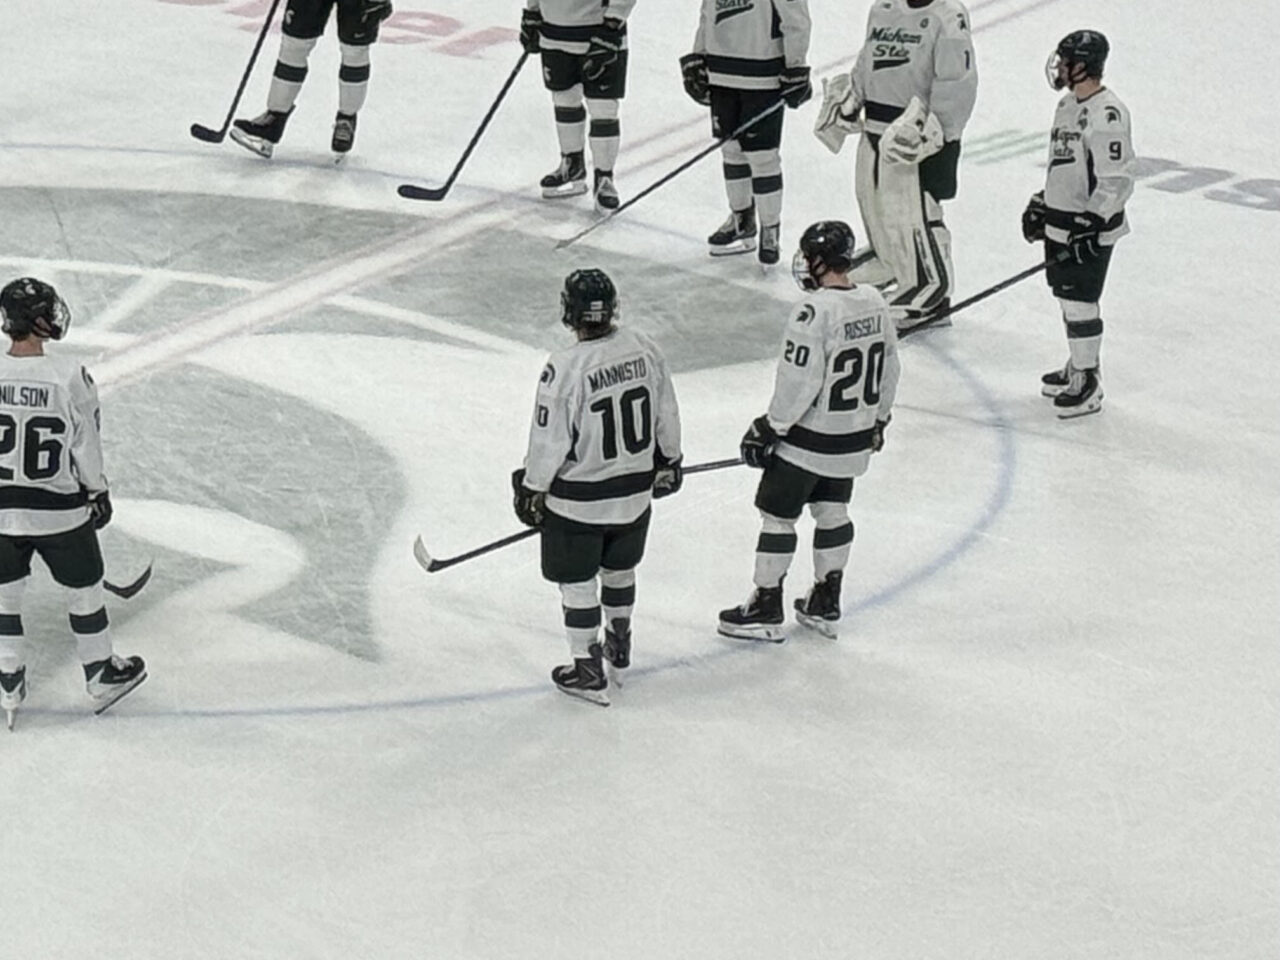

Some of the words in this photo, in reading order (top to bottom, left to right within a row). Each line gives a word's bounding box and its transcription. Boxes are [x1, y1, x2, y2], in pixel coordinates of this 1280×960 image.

[964, 49, 971, 71] 1
[1109, 141, 1122, 161] 9
[784, 340, 810, 367] 20
[828, 341, 885, 412] 20
[590, 385, 652, 460] 10
